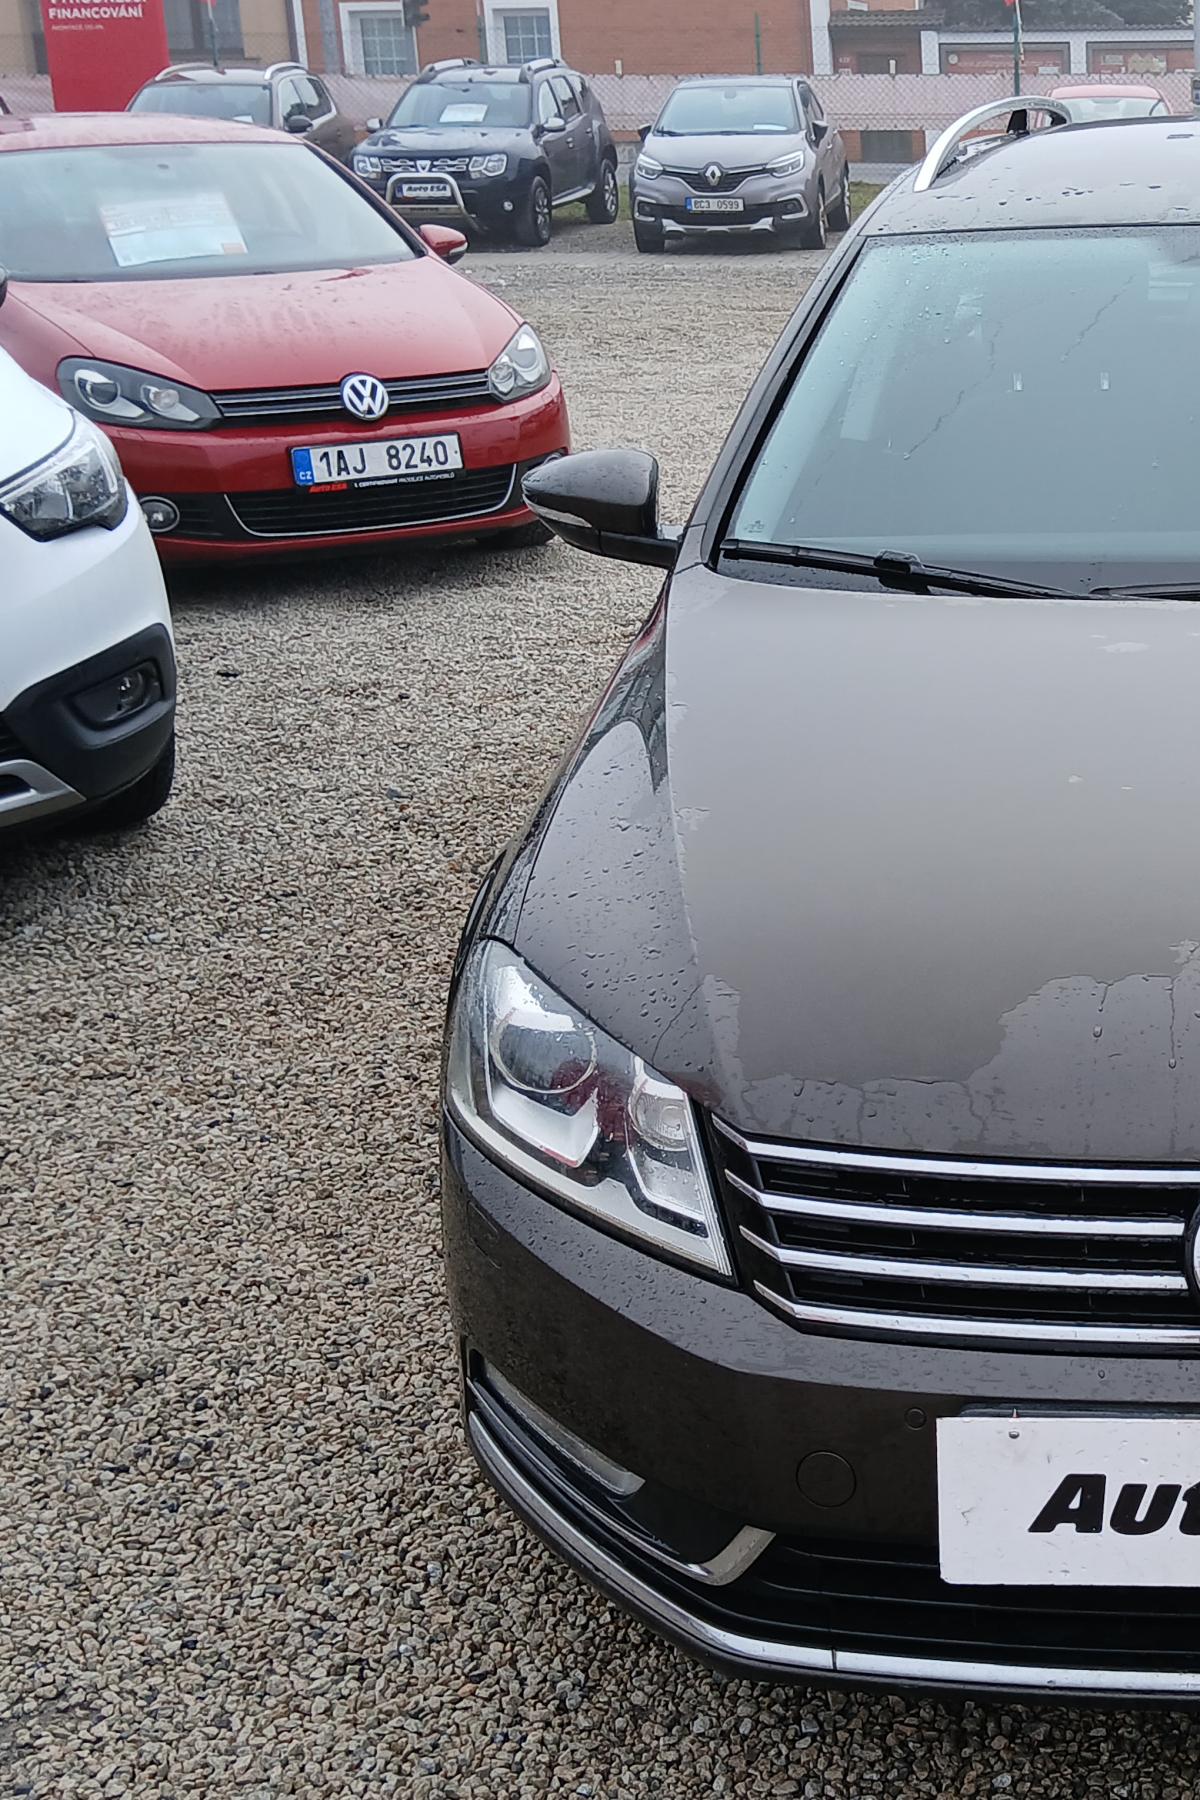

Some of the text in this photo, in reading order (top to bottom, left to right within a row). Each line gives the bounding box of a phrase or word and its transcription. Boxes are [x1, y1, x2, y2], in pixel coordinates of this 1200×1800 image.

[48, 3, 143, 19] FINANCOVÁNÍ
[716, 200, 739, 210] 0599
[299, 440, 449, 480] CZ 1AJ 8240
